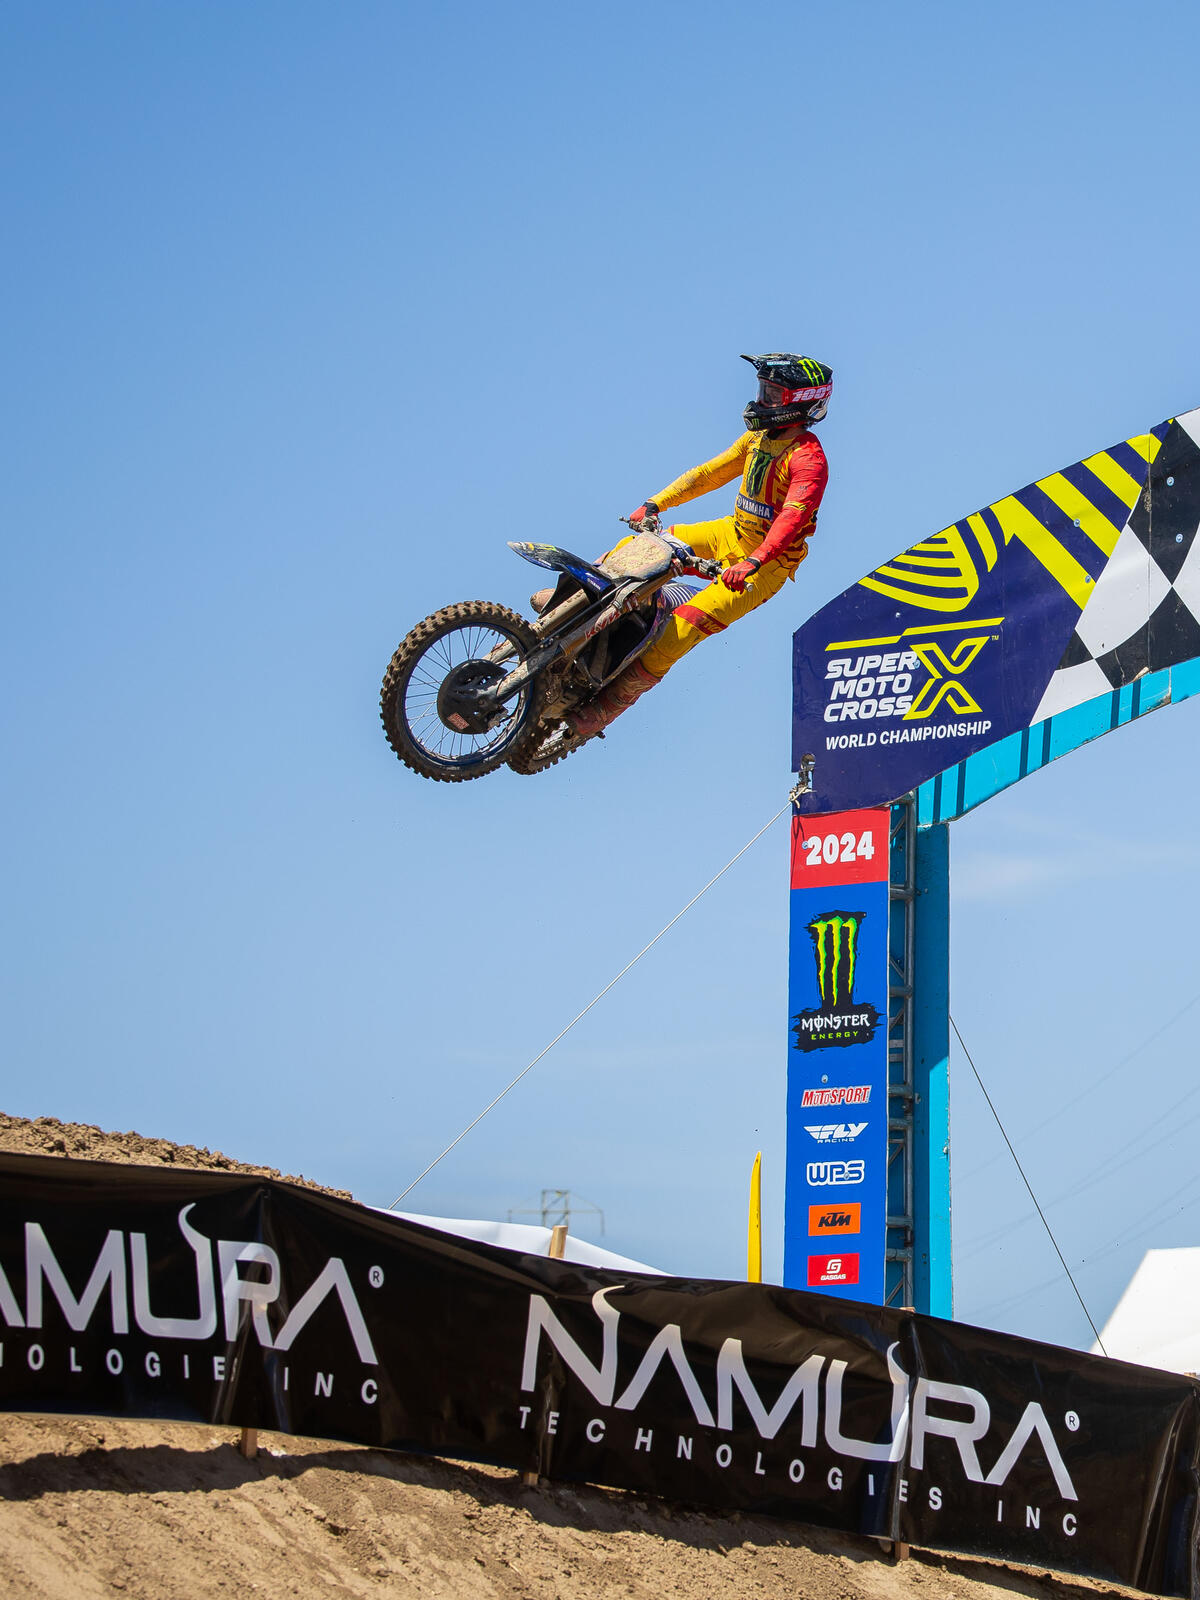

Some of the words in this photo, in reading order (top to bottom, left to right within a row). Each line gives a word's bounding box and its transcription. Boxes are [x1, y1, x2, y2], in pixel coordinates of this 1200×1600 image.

[742, 500, 770, 518] YAMAHA
[825, 651, 919, 679] SUPER
[830, 673, 912, 700] MOTO
[823, 695, 913, 723] CROSS
[826, 732, 876, 750] WORLD
[879, 720, 992, 745] CHAMPIONSHIP
[806, 831, 874, 866] 2024
[801, 1013, 870, 1031] MONSTER
[811, 1031, 859, 1041] ENERGY
[804, 1123, 869, 1139] FLY
[807, 1161, 865, 1186] WPS
[818, 1212, 851, 1228] KTM
[0, 1202, 379, 1366] MURA
[0, 1342, 238, 1382] OLOGIE
[282, 1366, 378, 1404] INC
[521, 1285, 1078, 1501] NAMURA
[519, 1406, 942, 1510] TECHNOLOGIES
[996, 1499, 1078, 1537] INC
